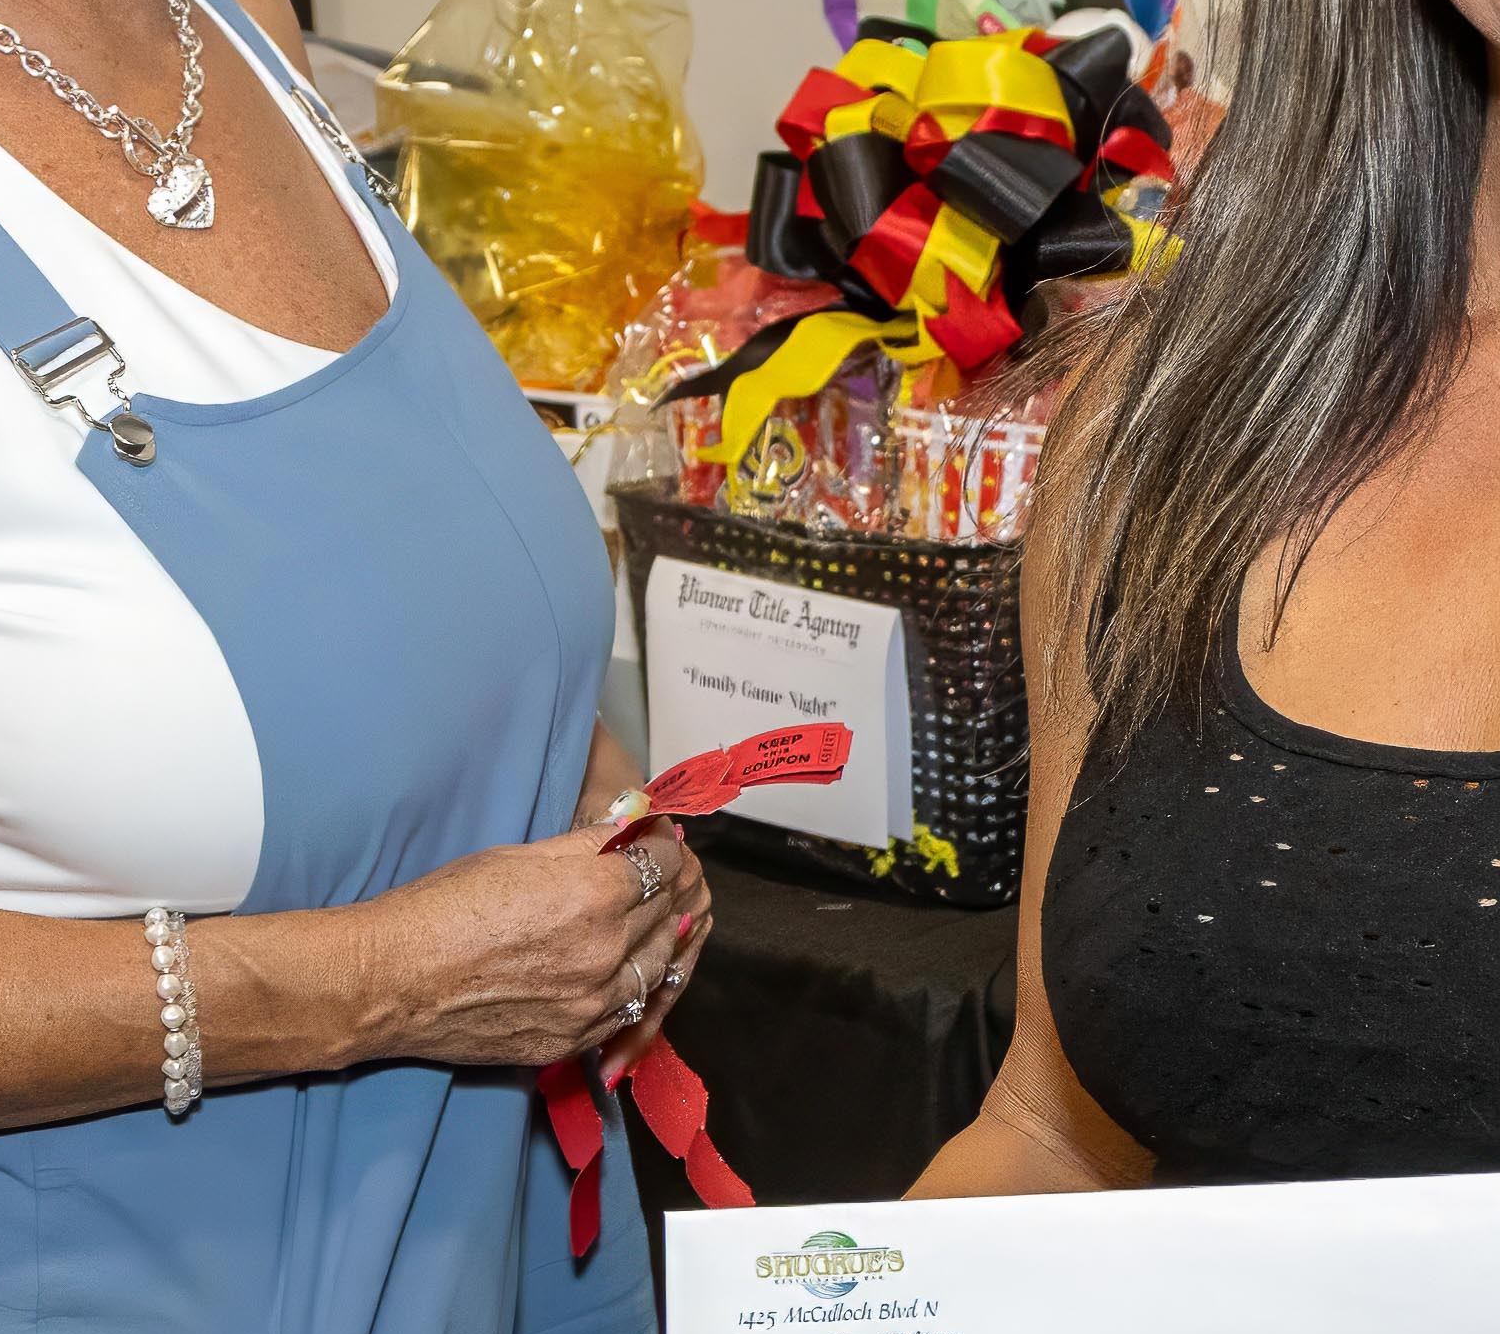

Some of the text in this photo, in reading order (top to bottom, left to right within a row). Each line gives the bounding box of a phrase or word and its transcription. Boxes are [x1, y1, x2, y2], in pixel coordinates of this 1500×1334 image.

[678, 572, 744, 614] Pioneer
[749, 588, 791, 625] Title
[793, 599, 862, 649] Agency
[741, 679, 783, 705] Game
[757, 733, 803, 752] KEEP
[742, 753, 811, 776] COUPON
[756, 1249, 906, 1279] SHUGRUE'S
[738, 1298, 939, 1330] 1425 McCulloch Blvd N
